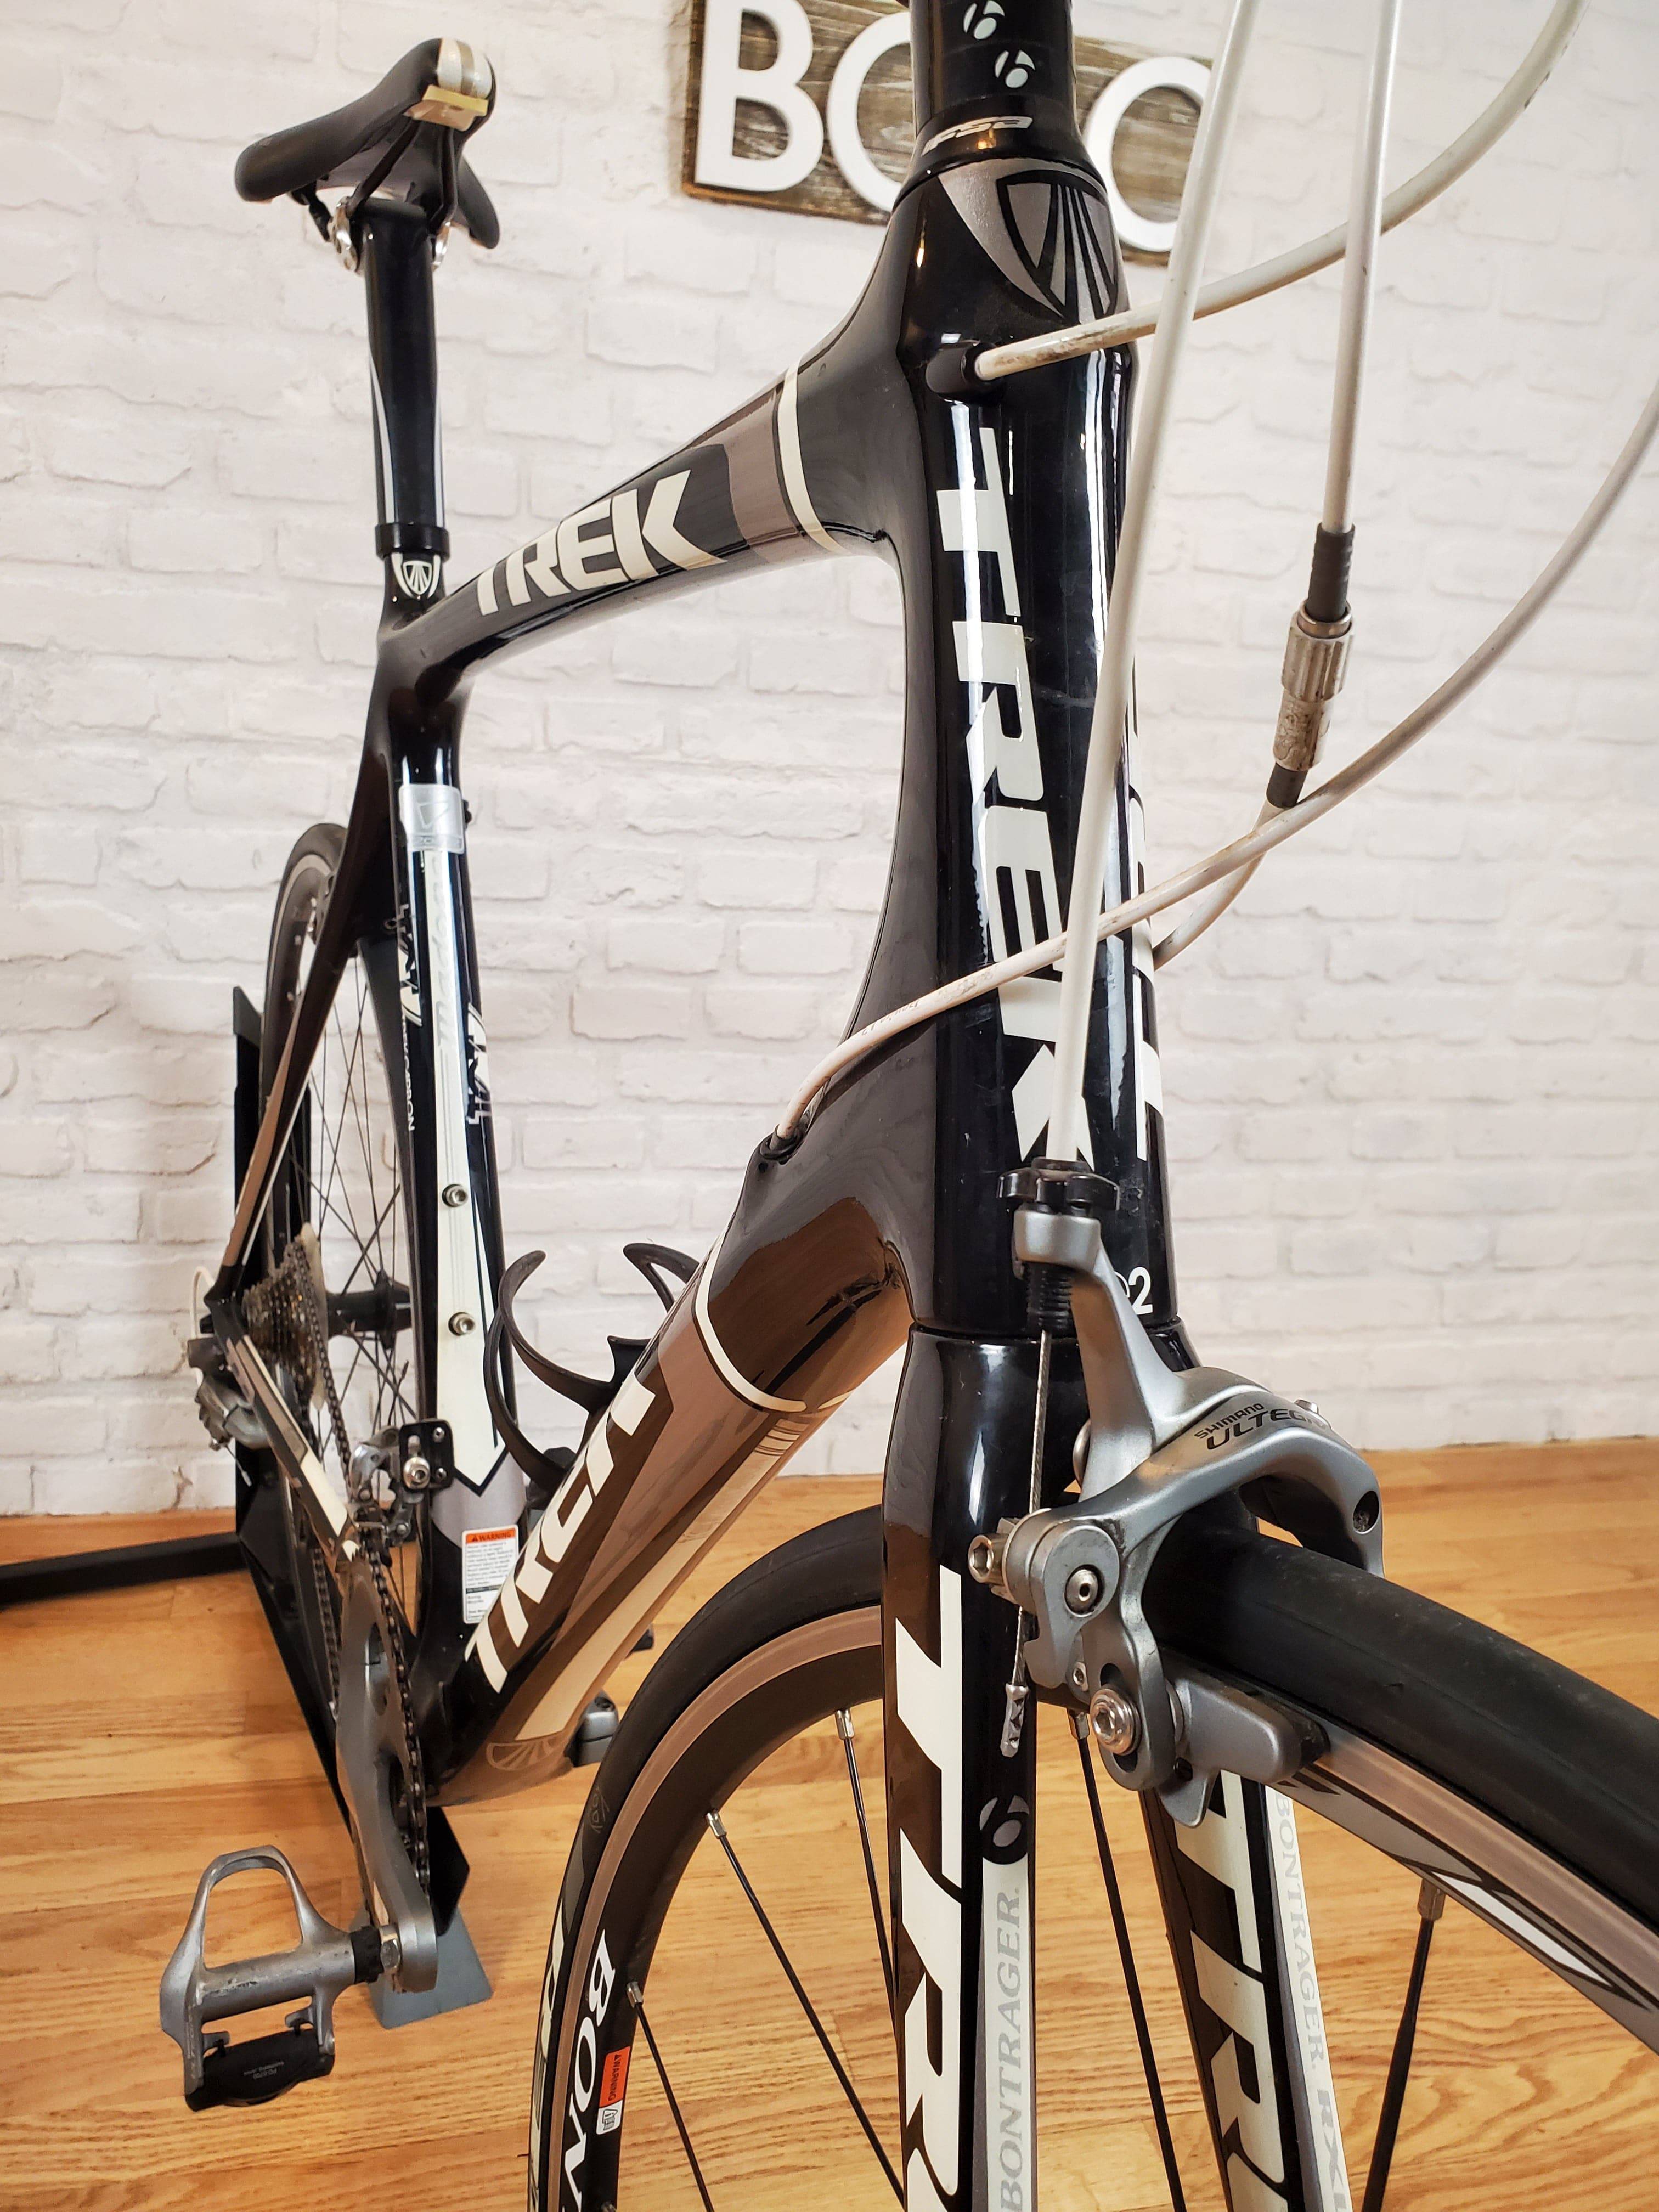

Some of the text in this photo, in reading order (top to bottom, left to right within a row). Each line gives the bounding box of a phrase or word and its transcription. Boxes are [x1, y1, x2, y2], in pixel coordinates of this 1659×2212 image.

[477, 470, 728, 616] TREK
[1114, 1266, 1153, 1315] 2
[1194, 1403, 1265, 1439] SHIMANO
[479, 1531, 511, 1542] WARNING
[560, 1929, 615, 2212] BON
[608, 2061, 621, 2101] WARNING
